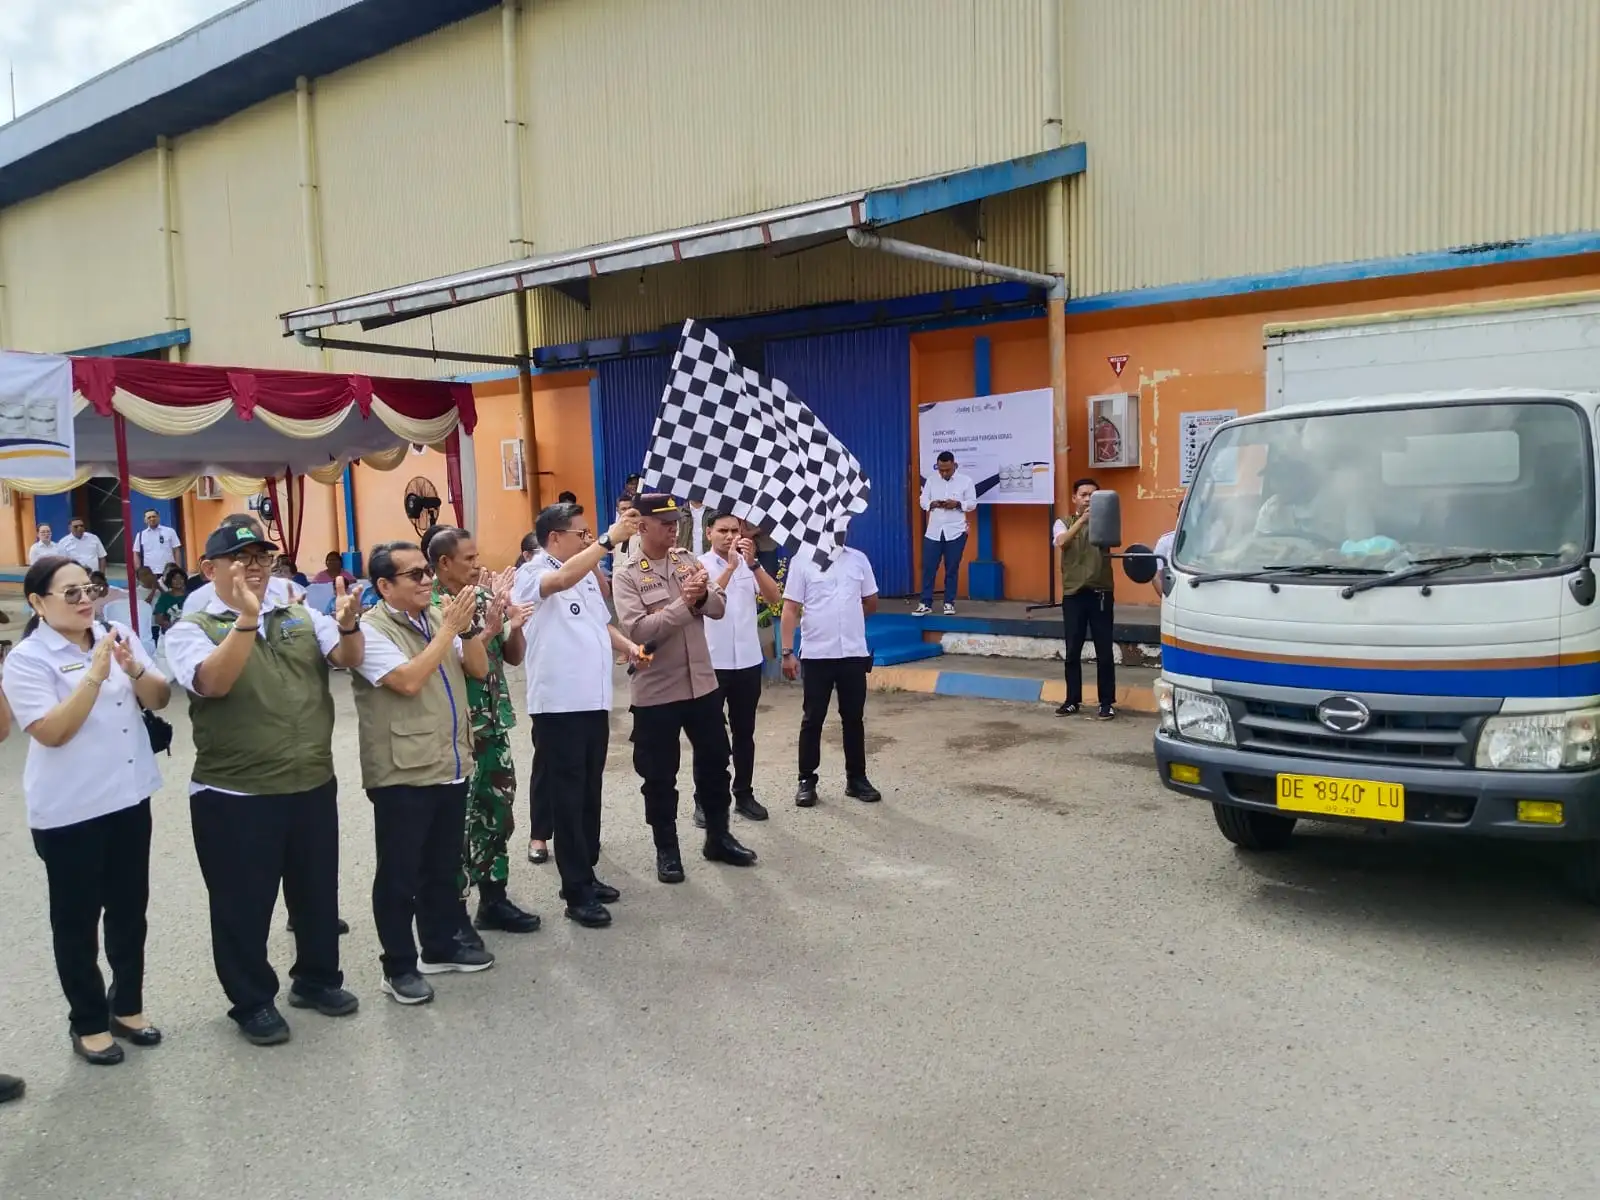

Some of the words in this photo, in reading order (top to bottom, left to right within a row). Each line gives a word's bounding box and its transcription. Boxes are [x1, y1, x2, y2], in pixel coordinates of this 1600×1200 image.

[1282, 778, 1304, 799] DE
[1317, 780, 1362, 804] 8940
[1378, 786, 1399, 808] LU
